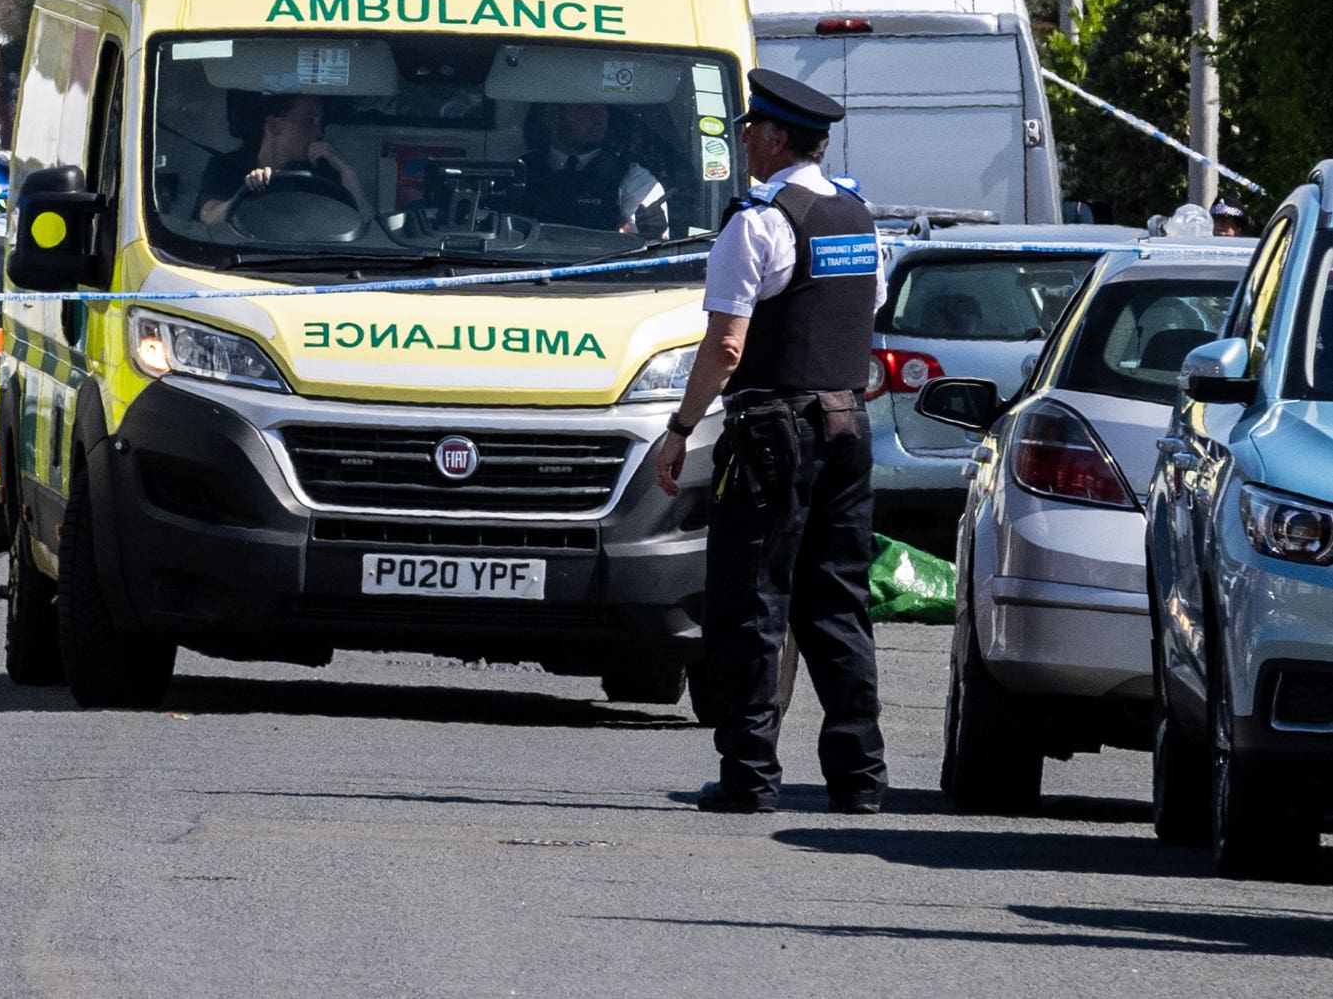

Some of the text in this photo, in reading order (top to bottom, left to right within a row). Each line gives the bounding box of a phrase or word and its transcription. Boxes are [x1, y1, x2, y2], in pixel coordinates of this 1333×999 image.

[815, 243, 876, 255] COMMUNITY SUPPOR
[827, 257, 851, 266] TRAFFIC
[445, 450, 469, 469] FIAT
[375, 557, 530, 590] PO20 YPF
